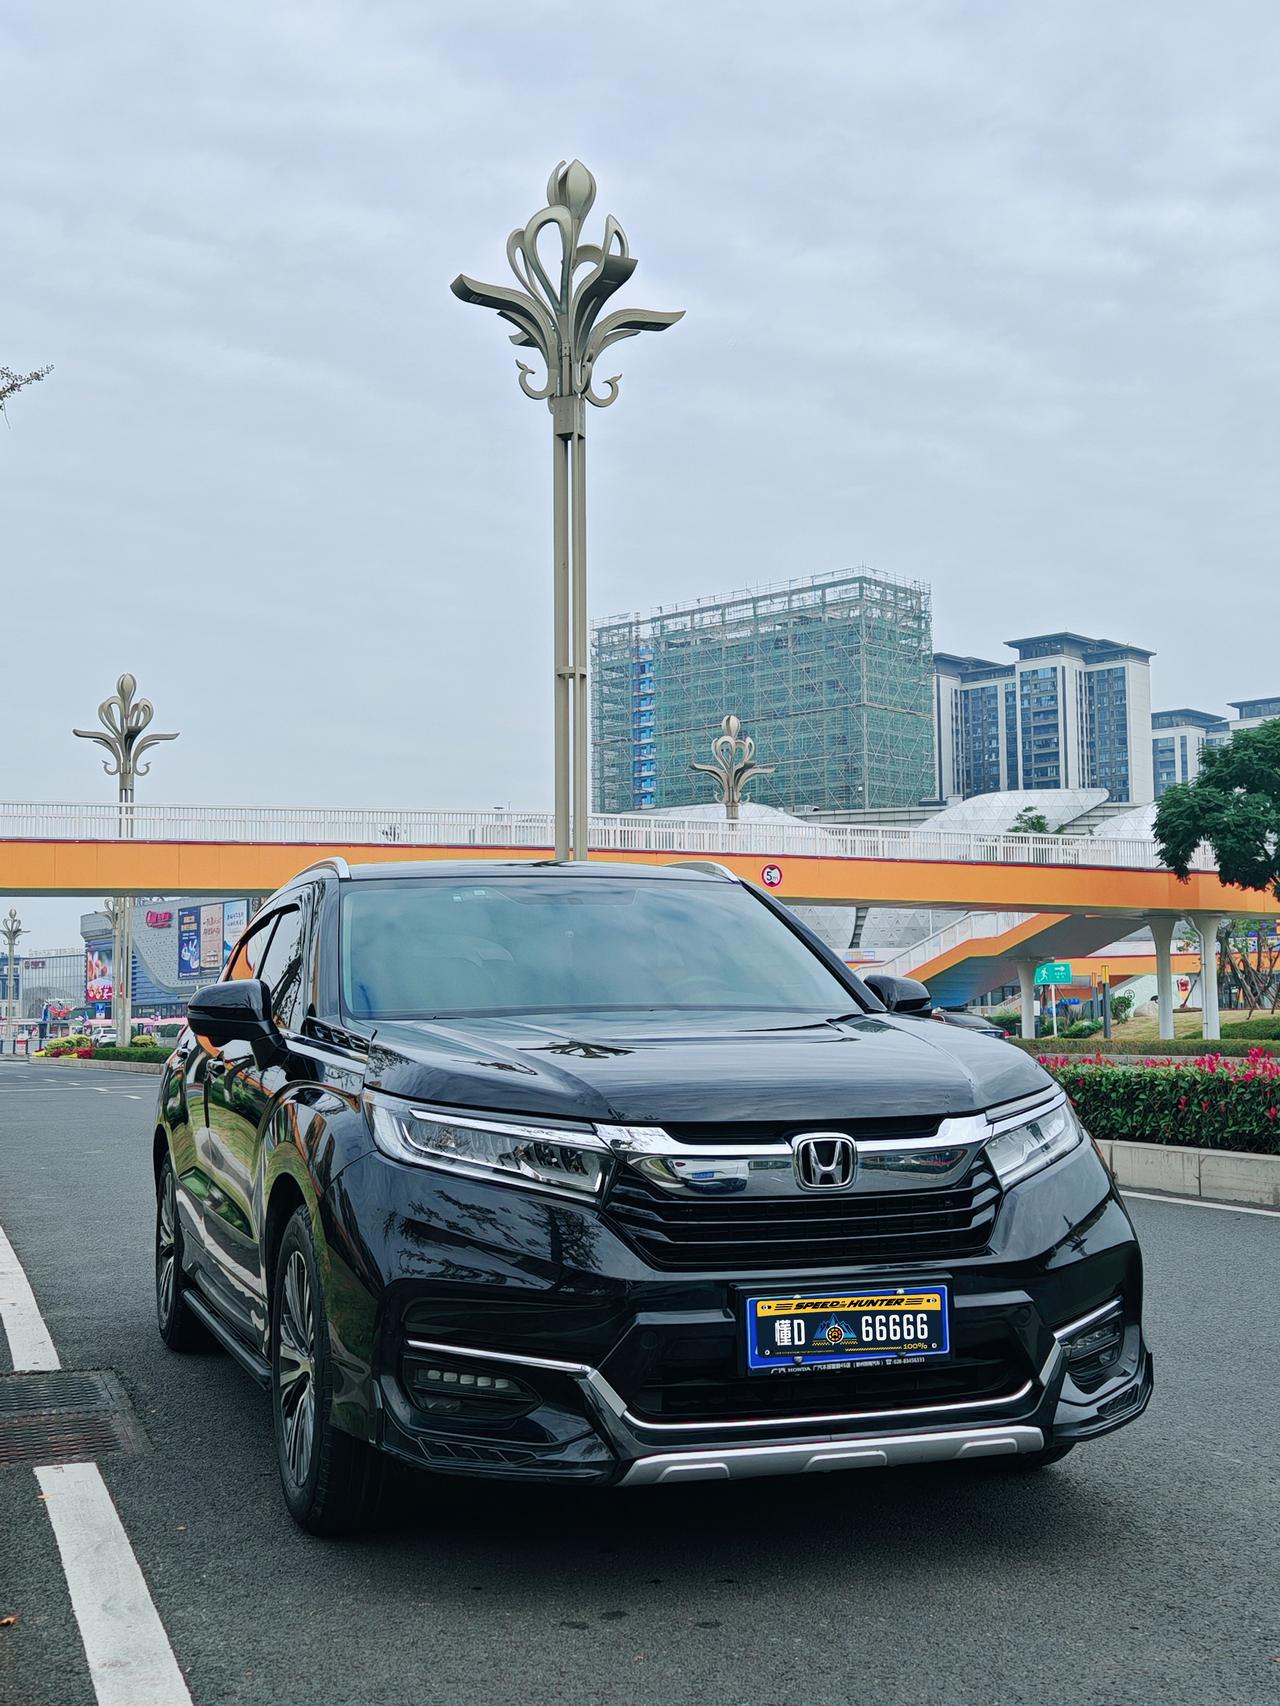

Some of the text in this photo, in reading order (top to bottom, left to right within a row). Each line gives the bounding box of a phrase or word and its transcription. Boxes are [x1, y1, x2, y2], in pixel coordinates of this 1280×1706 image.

[794, 1300, 840, 1310] SPEED
[847, 1298, 905, 1308] HUNTER
[861, 1313, 929, 1341] 66666
[903, 1342, 928, 1350] 100%
